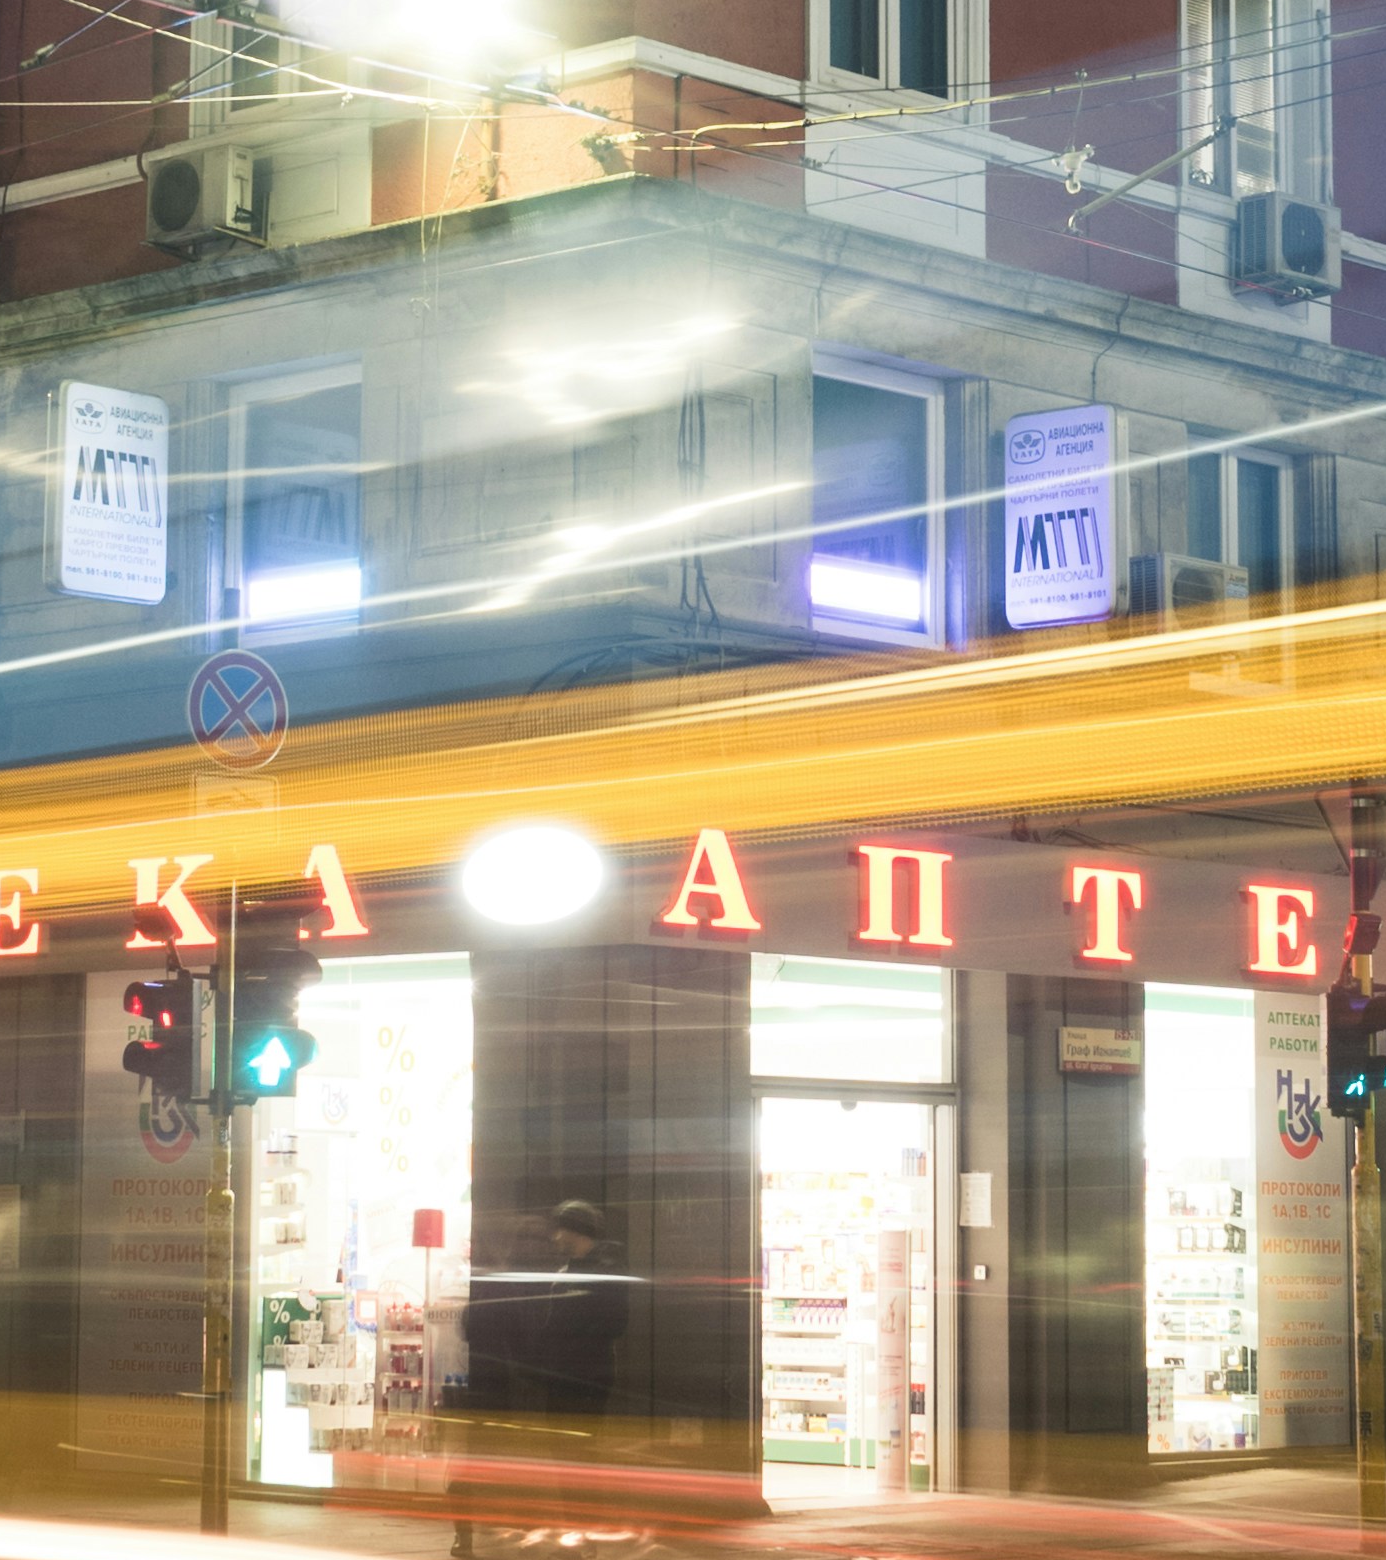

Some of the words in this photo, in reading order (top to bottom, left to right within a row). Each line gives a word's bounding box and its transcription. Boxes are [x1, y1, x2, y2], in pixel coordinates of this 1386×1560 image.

[76, 418, 102, 429] IATA
[110, 406, 162, 425] АВИАЦИОННА
[116, 424, 154, 441] АГЕНЦИЯ
[1048, 421, 1105, 440] АВИАЦИОННА
[1014, 449, 1041, 460] IATA
[1055, 440, 1094, 457] АГЕНЦИЯ
[1007, 468, 1065, 485] САМОЛЕТНИ
[1010, 491, 1059, 505] ЧАРТЪРНИ
[1061, 486, 1099, 499] ПОЛЕТИ
[69, 505, 154, 528] INTERNATIONAL
[66, 526, 124, 541] САМОЛЕТНИ
[126, 534, 162, 547] БИЛЕТИ
[119, 554, 156, 567] ПОЛЕТИ
[1011, 568, 1095, 588] INTERNATIONAL
[1067, 1044, 1090, 1057] Граф
[1270, 1037, 1317, 1052] РАБОТИ
[1261, 1181, 1341, 1197] ПРОТОКОЛИ
[112, 1244, 204, 1263] ИНСУЛИН
[1263, 1239, 1341, 1255] ИНСУЛИНИ
[1282, 1321, 1316, 1331] ЖЪЛТИ
[1265, 1336, 1300, 1346] ЗЕЛЕНИ
[1301, 1337, 1343, 1347] РЕЦЕПТИ
[158, 1361, 204, 1375] РЕЦЕПТ
[1279, 1370, 1328, 1380] ПРИГОТВЯ
[1264, 1388, 1344, 1400] ЕКСТЕМПОРАЛНИ
